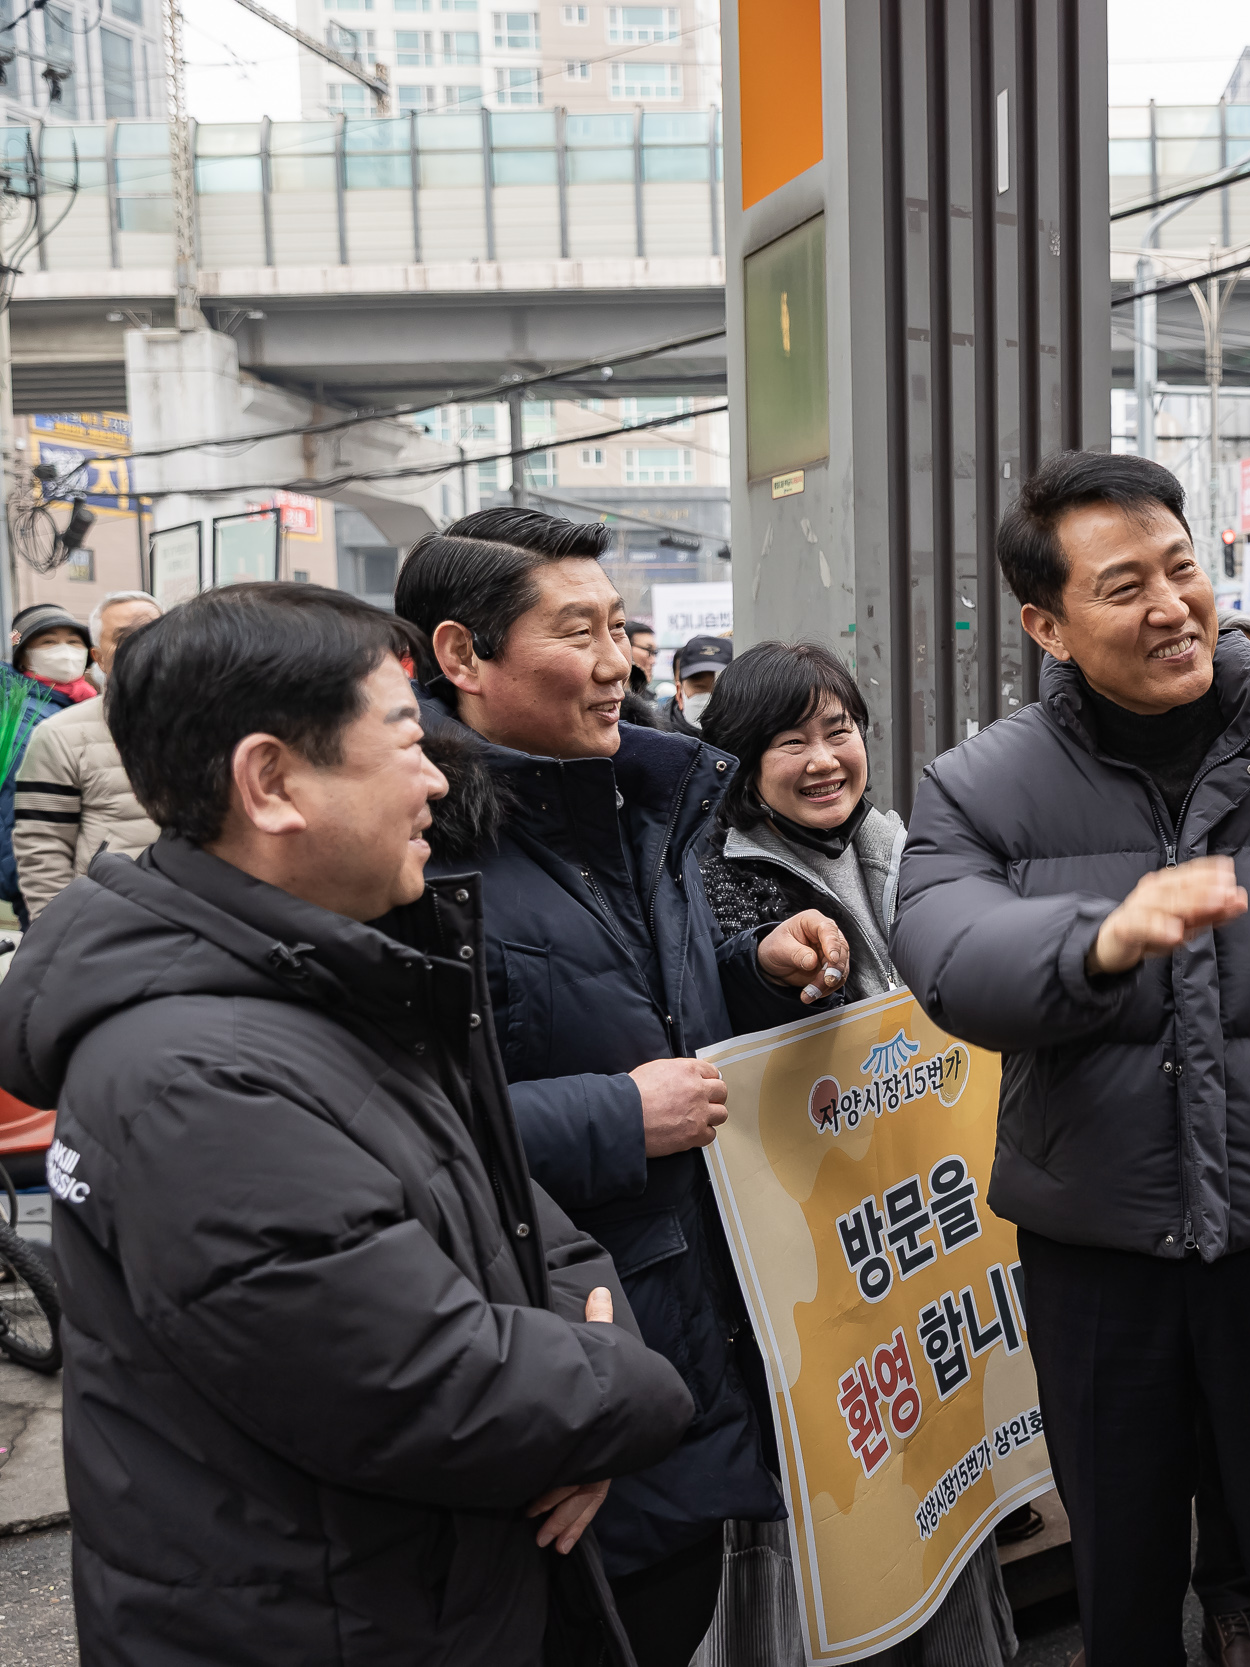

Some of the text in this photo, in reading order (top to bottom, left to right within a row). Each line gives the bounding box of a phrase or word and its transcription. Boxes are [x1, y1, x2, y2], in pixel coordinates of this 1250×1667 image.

[818, 1049, 962, 1133] 자양시장15번가
[837, 1158, 980, 1299] 방문을
[839, 1264, 1027, 1474] 환영 합니
[915, 1439, 992, 1537] 자양시장15번가
